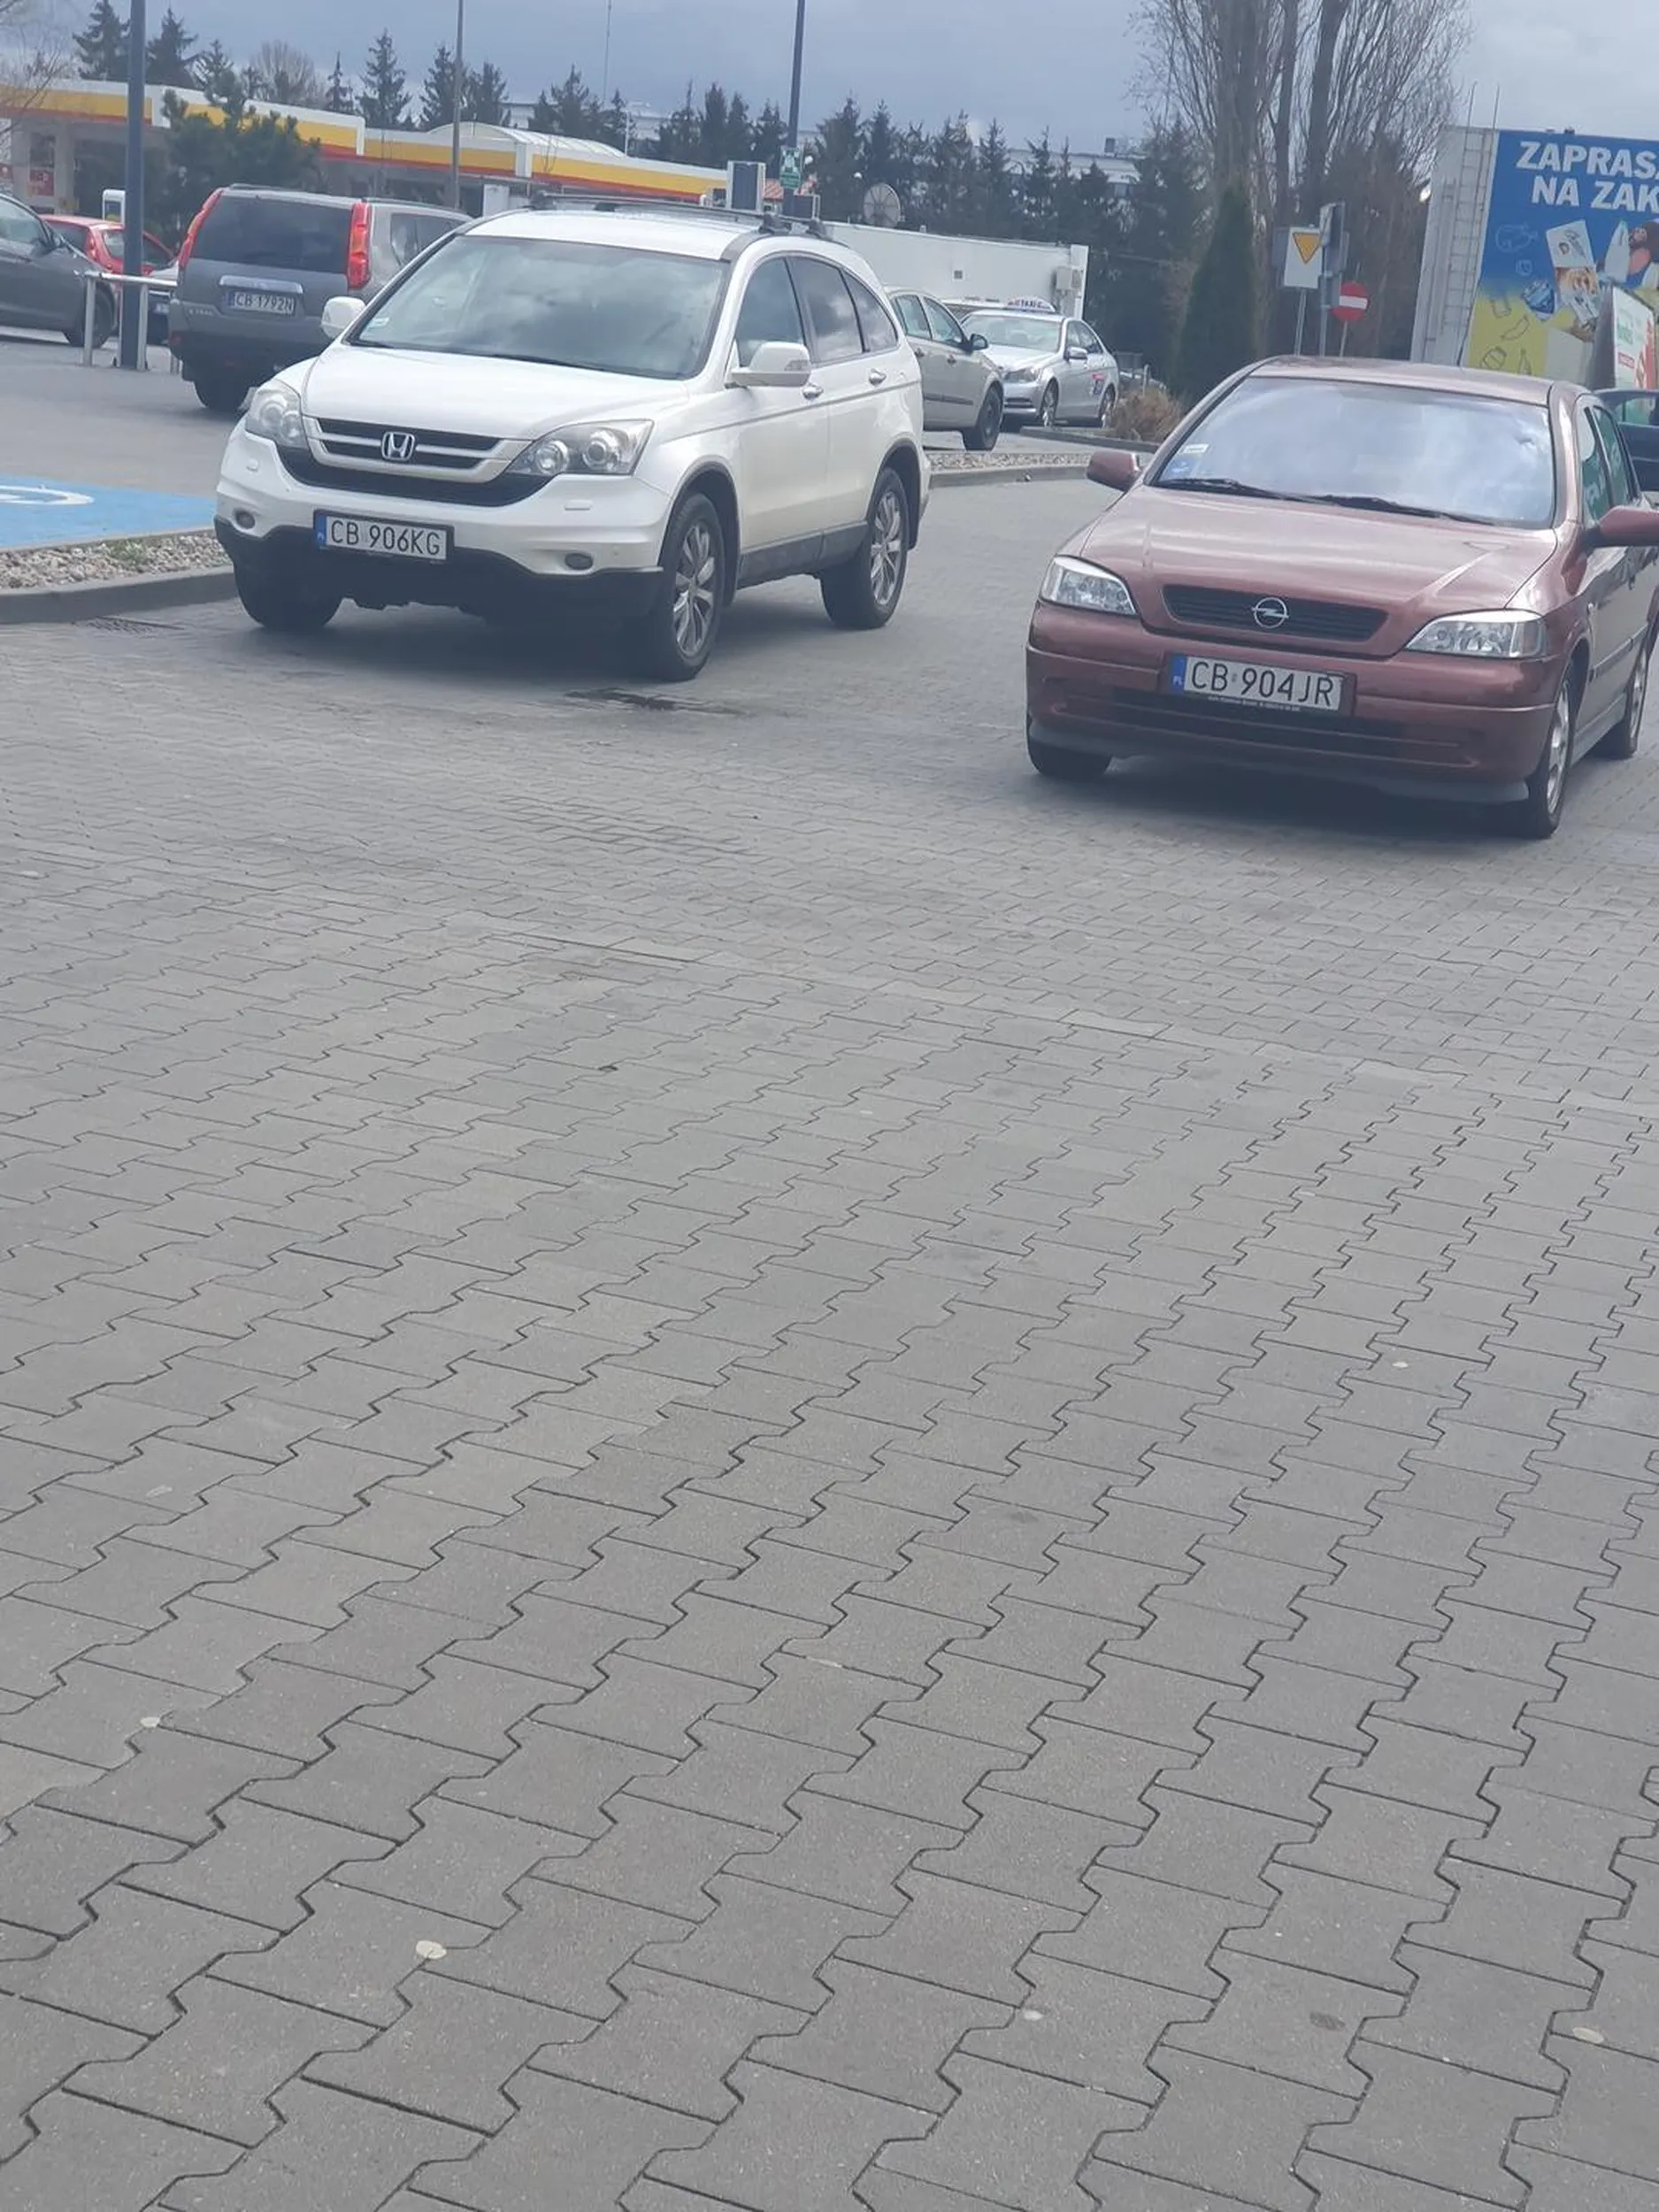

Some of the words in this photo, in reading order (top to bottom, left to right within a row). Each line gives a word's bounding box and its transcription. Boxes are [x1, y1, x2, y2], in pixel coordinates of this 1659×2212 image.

[1516, 141, 1659, 180] ZAPRAS
[1532, 175, 1579, 206] NA
[1590, 180, 1659, 214] ZAK
[235, 292, 253, 307] CB
[331, 520, 359, 545] CB
[369, 525, 441, 556] 906KG
[1192, 661, 1228, 692] CB
[1240, 667, 1334, 707] 904JR
